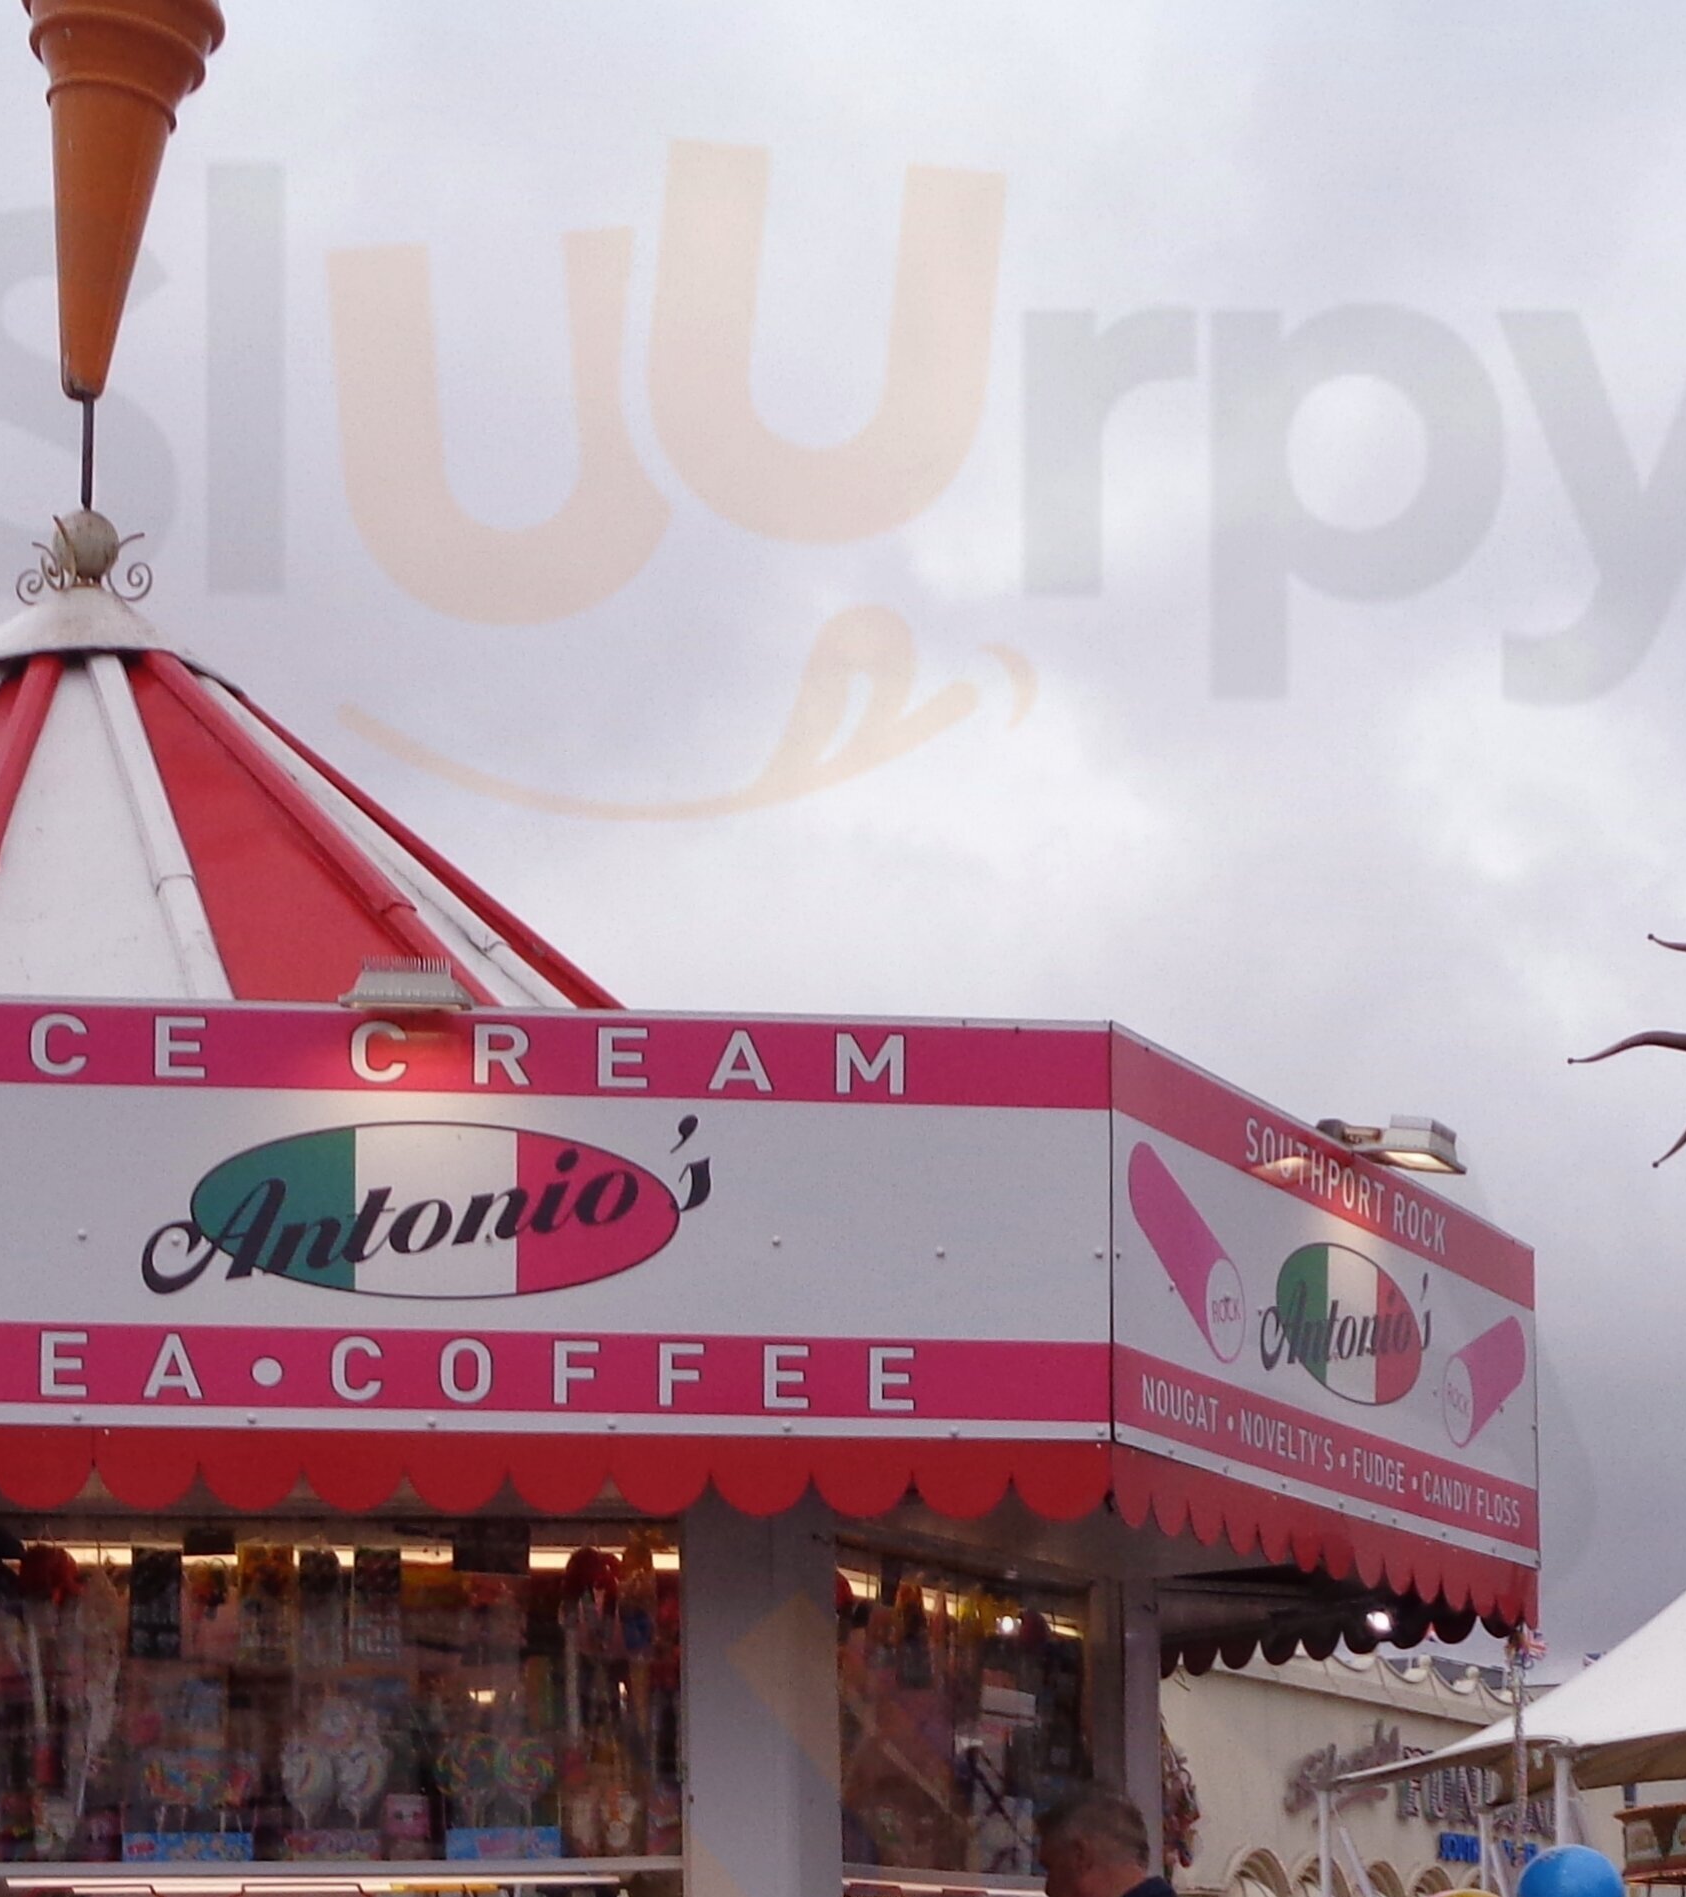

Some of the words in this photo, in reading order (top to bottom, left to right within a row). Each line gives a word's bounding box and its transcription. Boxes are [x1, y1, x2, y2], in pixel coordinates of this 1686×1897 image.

[349, 1019, 906, 1096] CREAM
[141, 1114, 712, 1294] Antonio's
[1244, 1117, 1386, 1223] SOUTHPORT
[1393, 1203, 1447, 1256] ROCK
[1213, 1292, 1242, 1327] ROCK
[1259, 1271, 1433, 1372] Antonio's
[330, 1335, 916, 1412] COFFEE
[1140, 1372, 1219, 1432] NOUGAT
[1239, 1411, 1335, 1472] NOVELTY'S
[1351, 1447, 1406, 1494] FUDGE
[1422, 1470, 1472, 1513] CANDY
[1476, 1486, 1522, 1529] FLOSS
